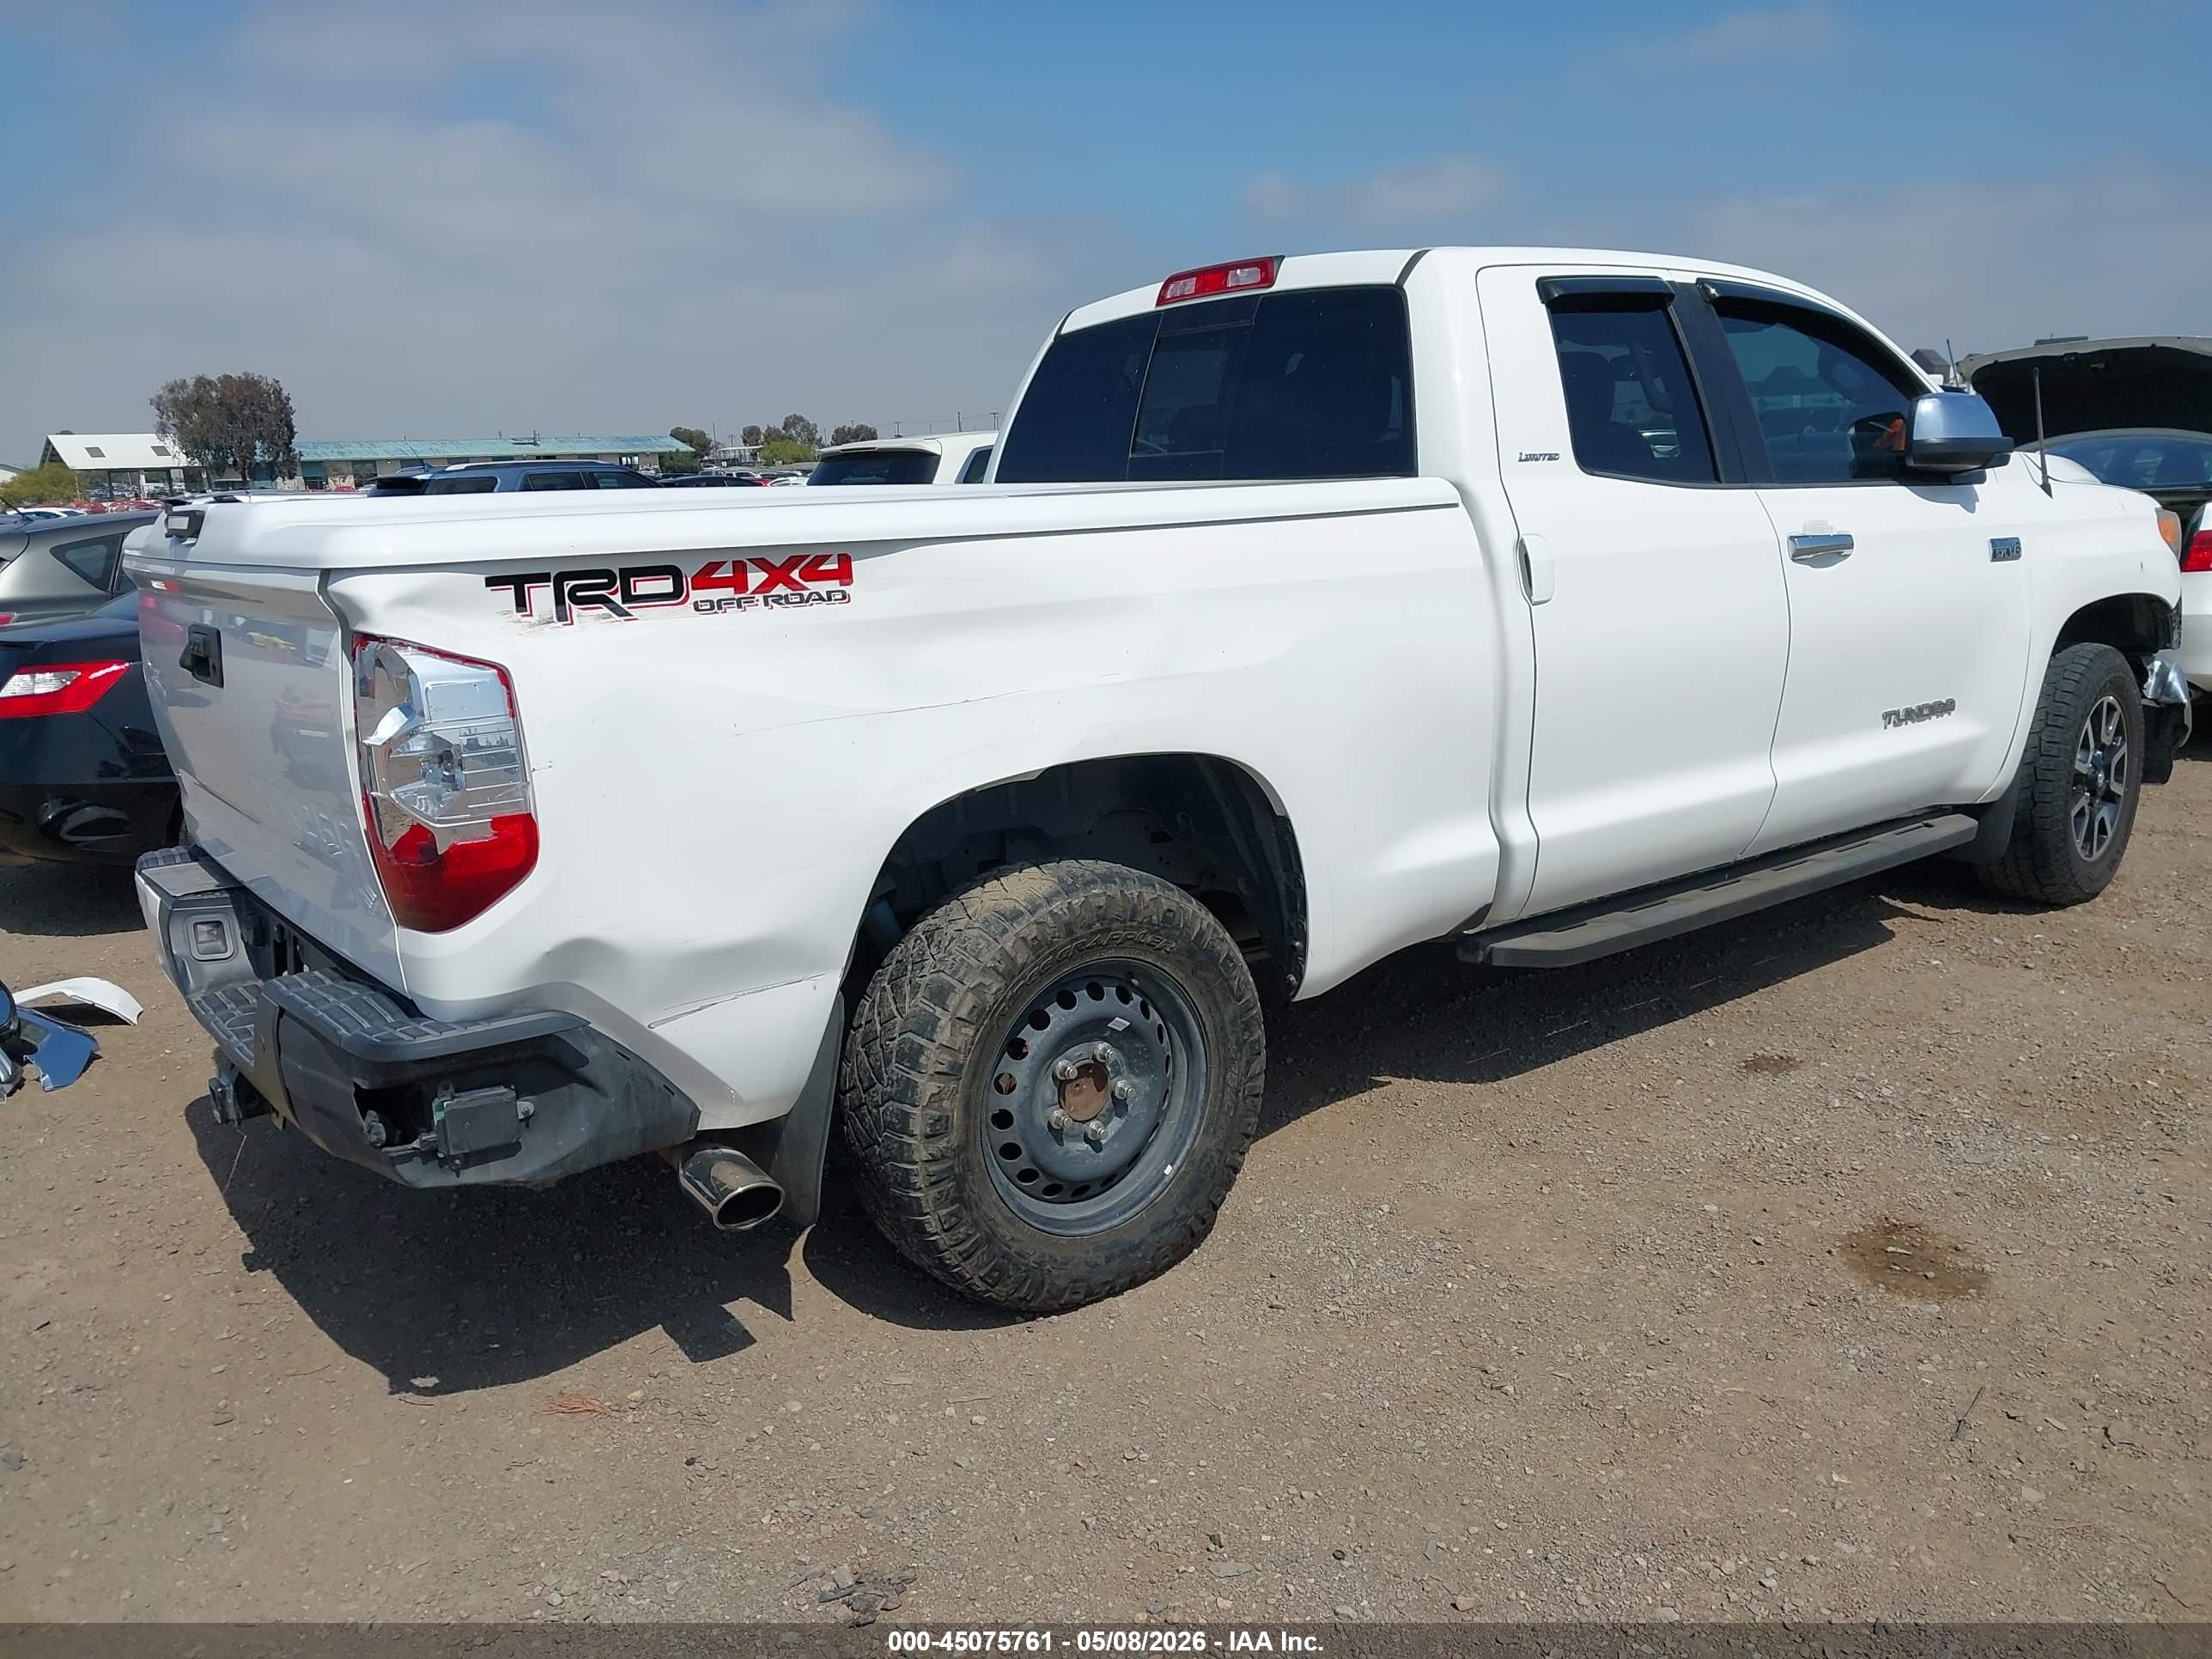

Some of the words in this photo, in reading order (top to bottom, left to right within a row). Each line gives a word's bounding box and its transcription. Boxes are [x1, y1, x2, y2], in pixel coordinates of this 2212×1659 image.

[485, 564, 690, 627] TRD
[690, 553, 854, 594] 4X4
[693, 596, 757, 615] OFF
[763, 589, 851, 611] ROAD
[1882, 697, 1956, 730] TUNDRA
